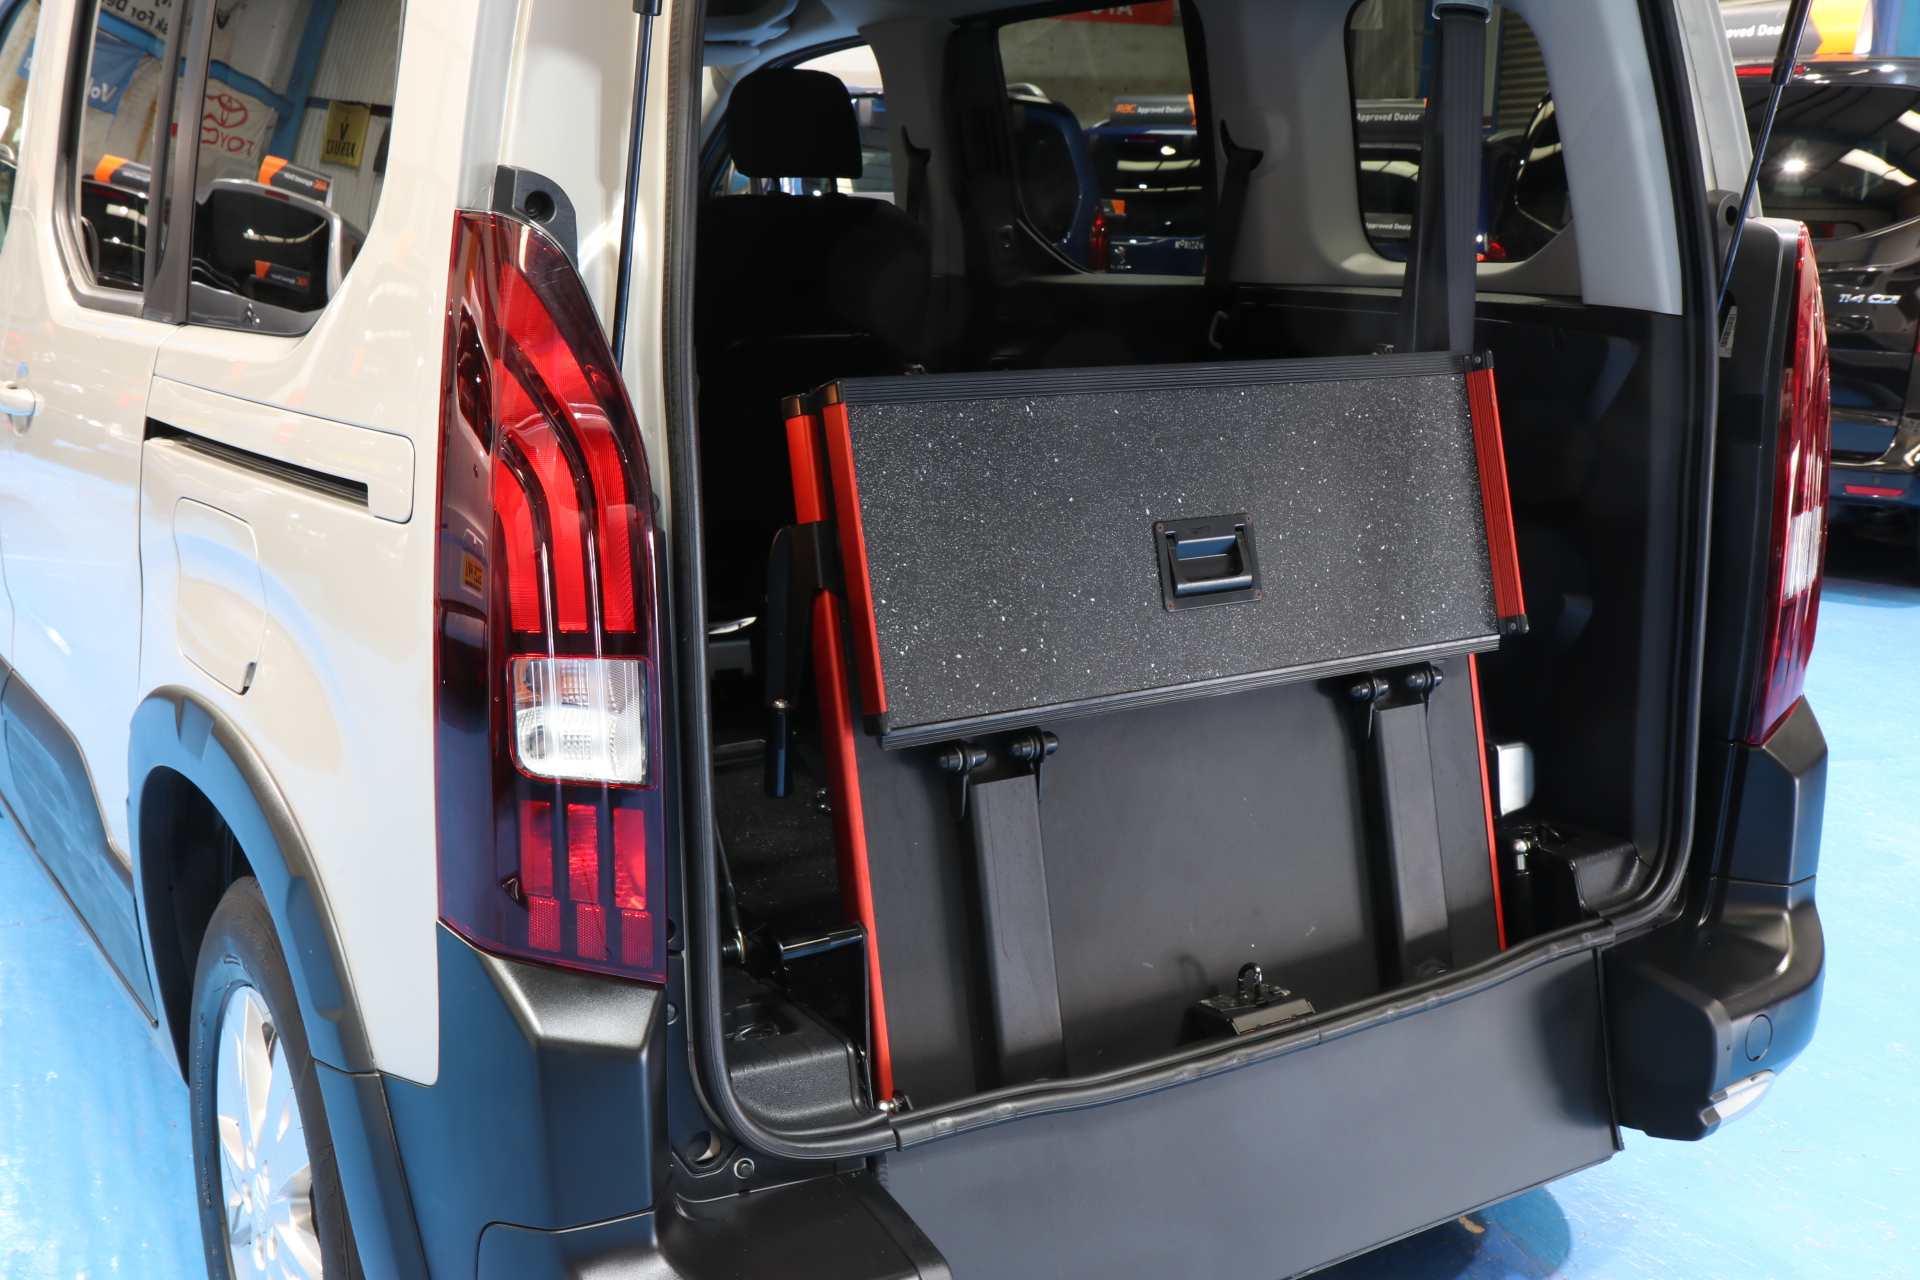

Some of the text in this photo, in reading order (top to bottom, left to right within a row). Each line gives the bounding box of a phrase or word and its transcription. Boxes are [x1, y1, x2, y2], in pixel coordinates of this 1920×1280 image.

[1137, 105, 1165, 115] Approved
[1165, 105, 1186, 114] Dealer
[1394, 112, 1421, 121] Dealer
